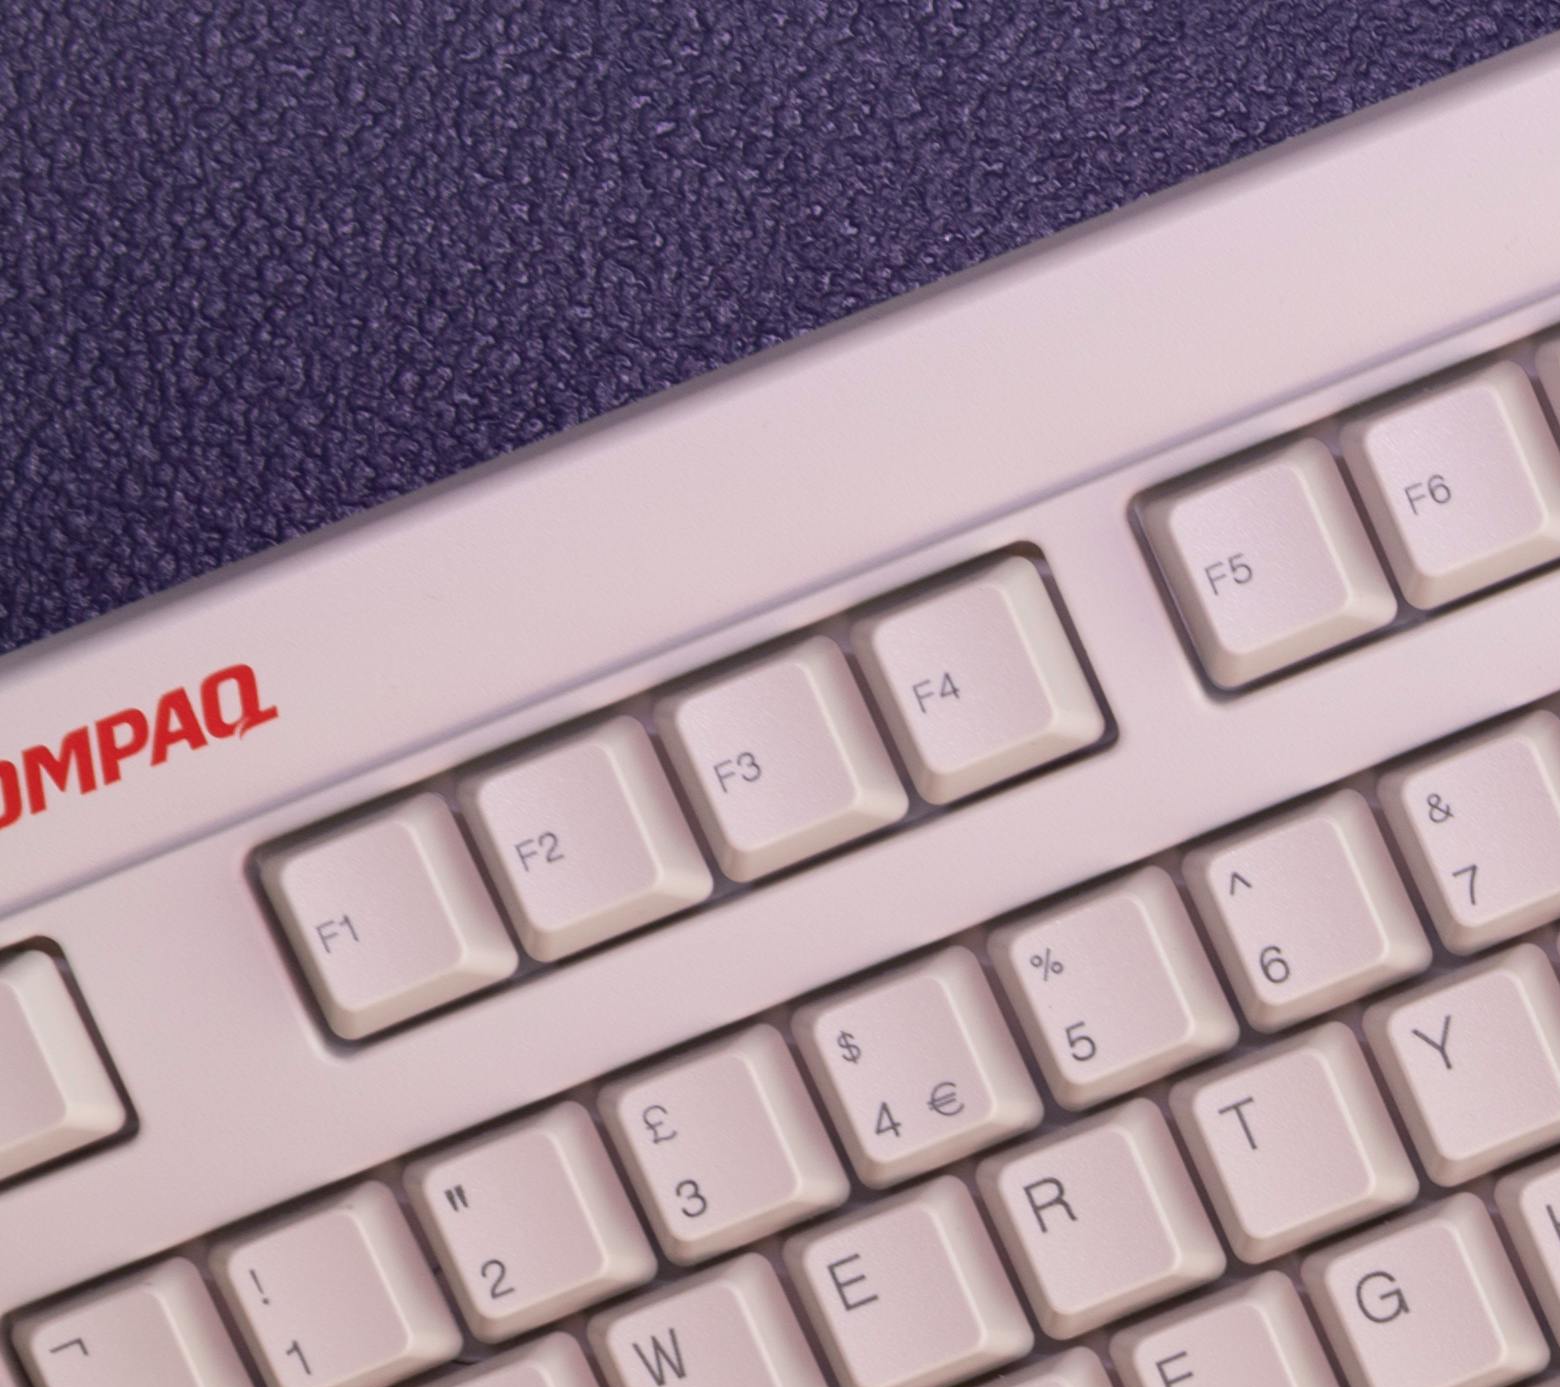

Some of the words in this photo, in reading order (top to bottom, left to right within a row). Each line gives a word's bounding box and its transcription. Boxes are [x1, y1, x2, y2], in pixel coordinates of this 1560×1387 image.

[1404, 474, 1452, 516] F6
[1204, 553, 1254, 596] F5
[912, 671, 961, 714] F4
[713, 751, 762, 793] F3
[514, 831, 565, 872] F2
[1451, 863, 1478, 906] 7
[315, 914, 360, 954] F1
[1259, 945, 1291, 985] 6
[1065, 1021, 1097, 1062] 5
[1411, 1014, 1453, 1071] Y
[874, 1101, 902, 1138] 4
[1217, 1096, 1258, 1151] T
[675, 1179, 708, 1219] 3
[1023, 1176, 1078, 1234] R
[480, 1258, 515, 1300] 2
[826, 1253, 879, 1312] E
[1355, 1270, 1410, 1324] G
[285, 1340, 312, 1376] 1
[631, 1327, 687, 1387] W
